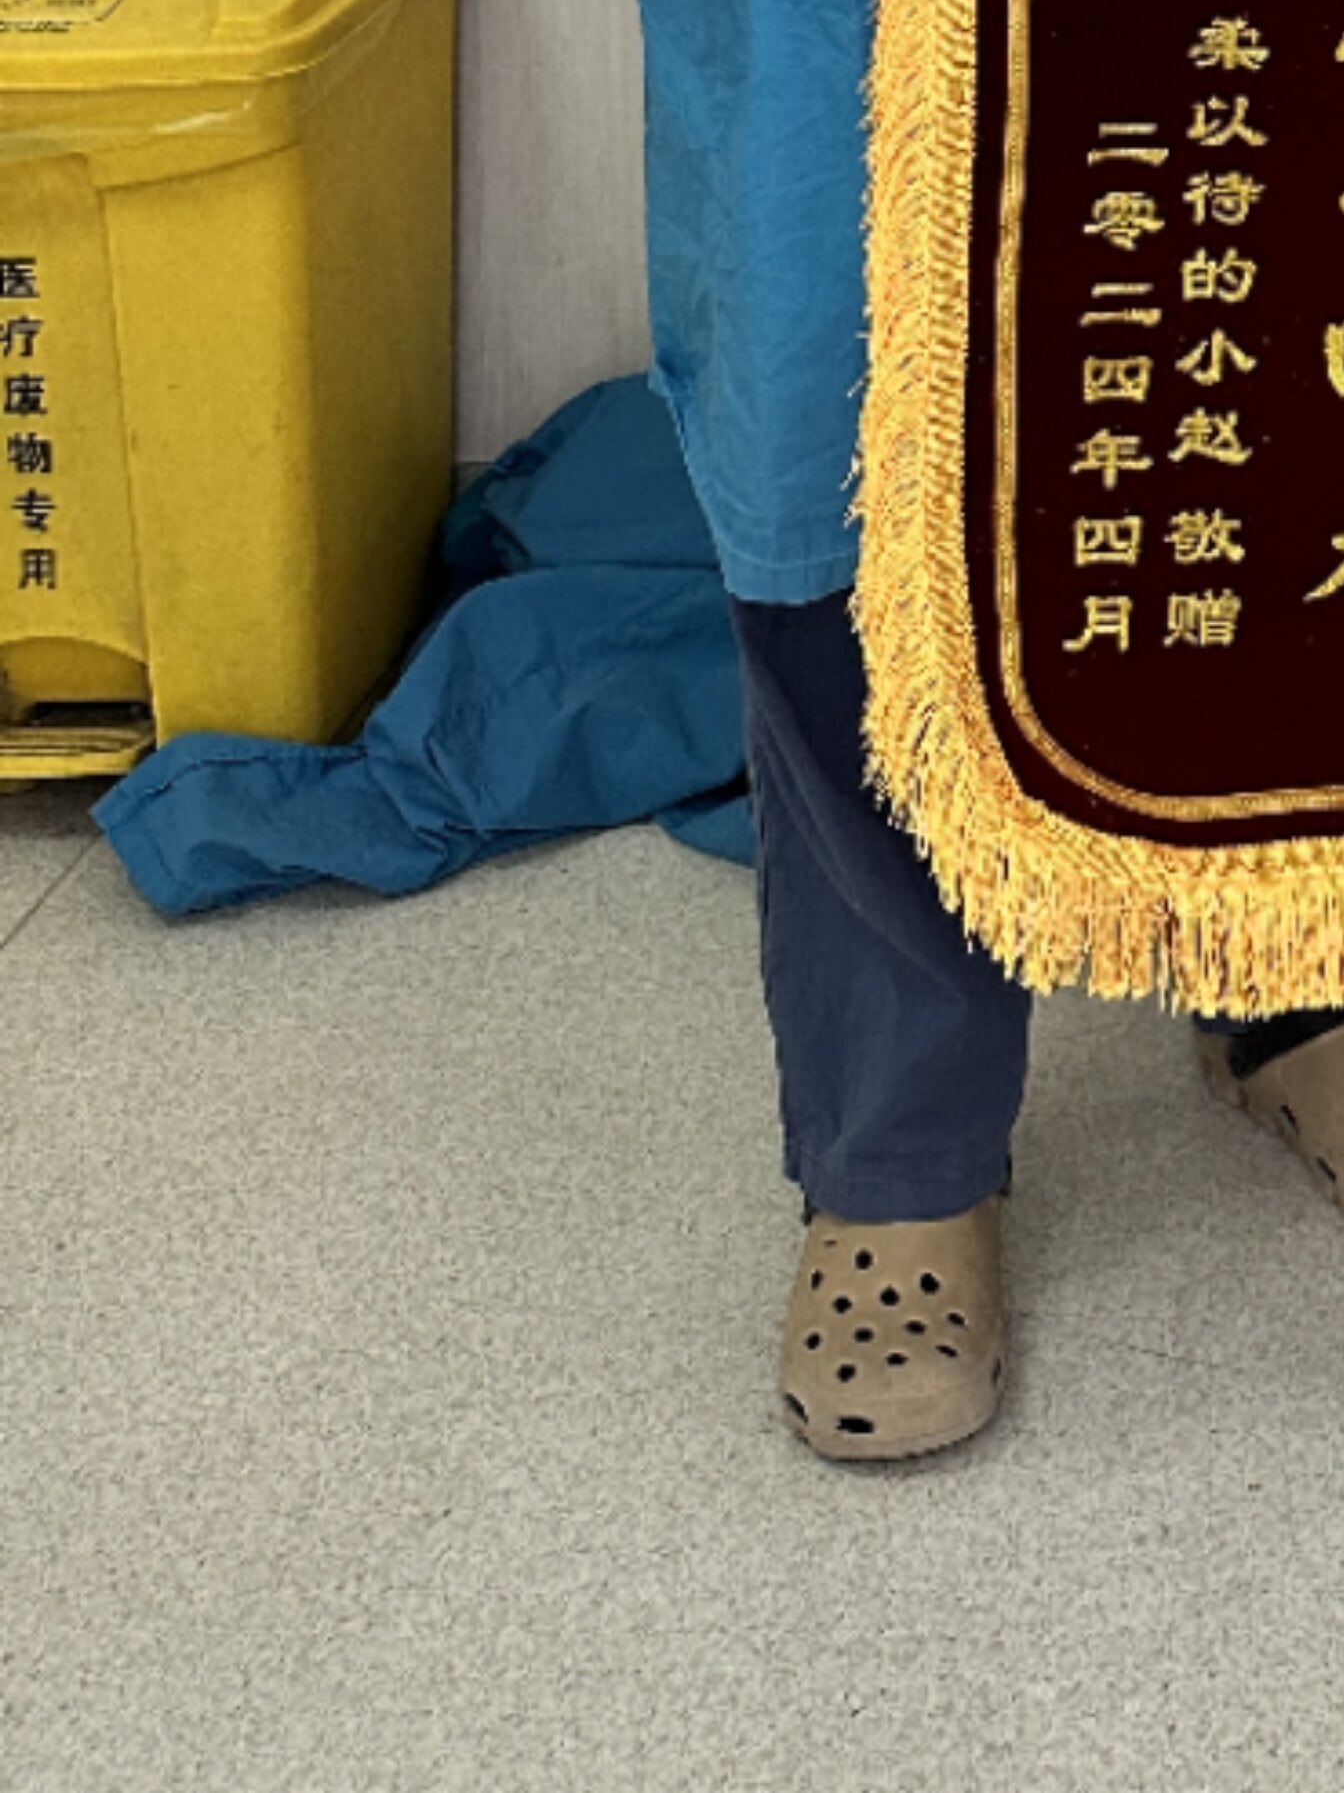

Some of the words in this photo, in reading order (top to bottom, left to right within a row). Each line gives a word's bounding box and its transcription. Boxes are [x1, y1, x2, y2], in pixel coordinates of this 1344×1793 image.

[0, 257, 57, 591] 医疗废物专用
[1061, 122, 1170, 653] 二零二四年四月
